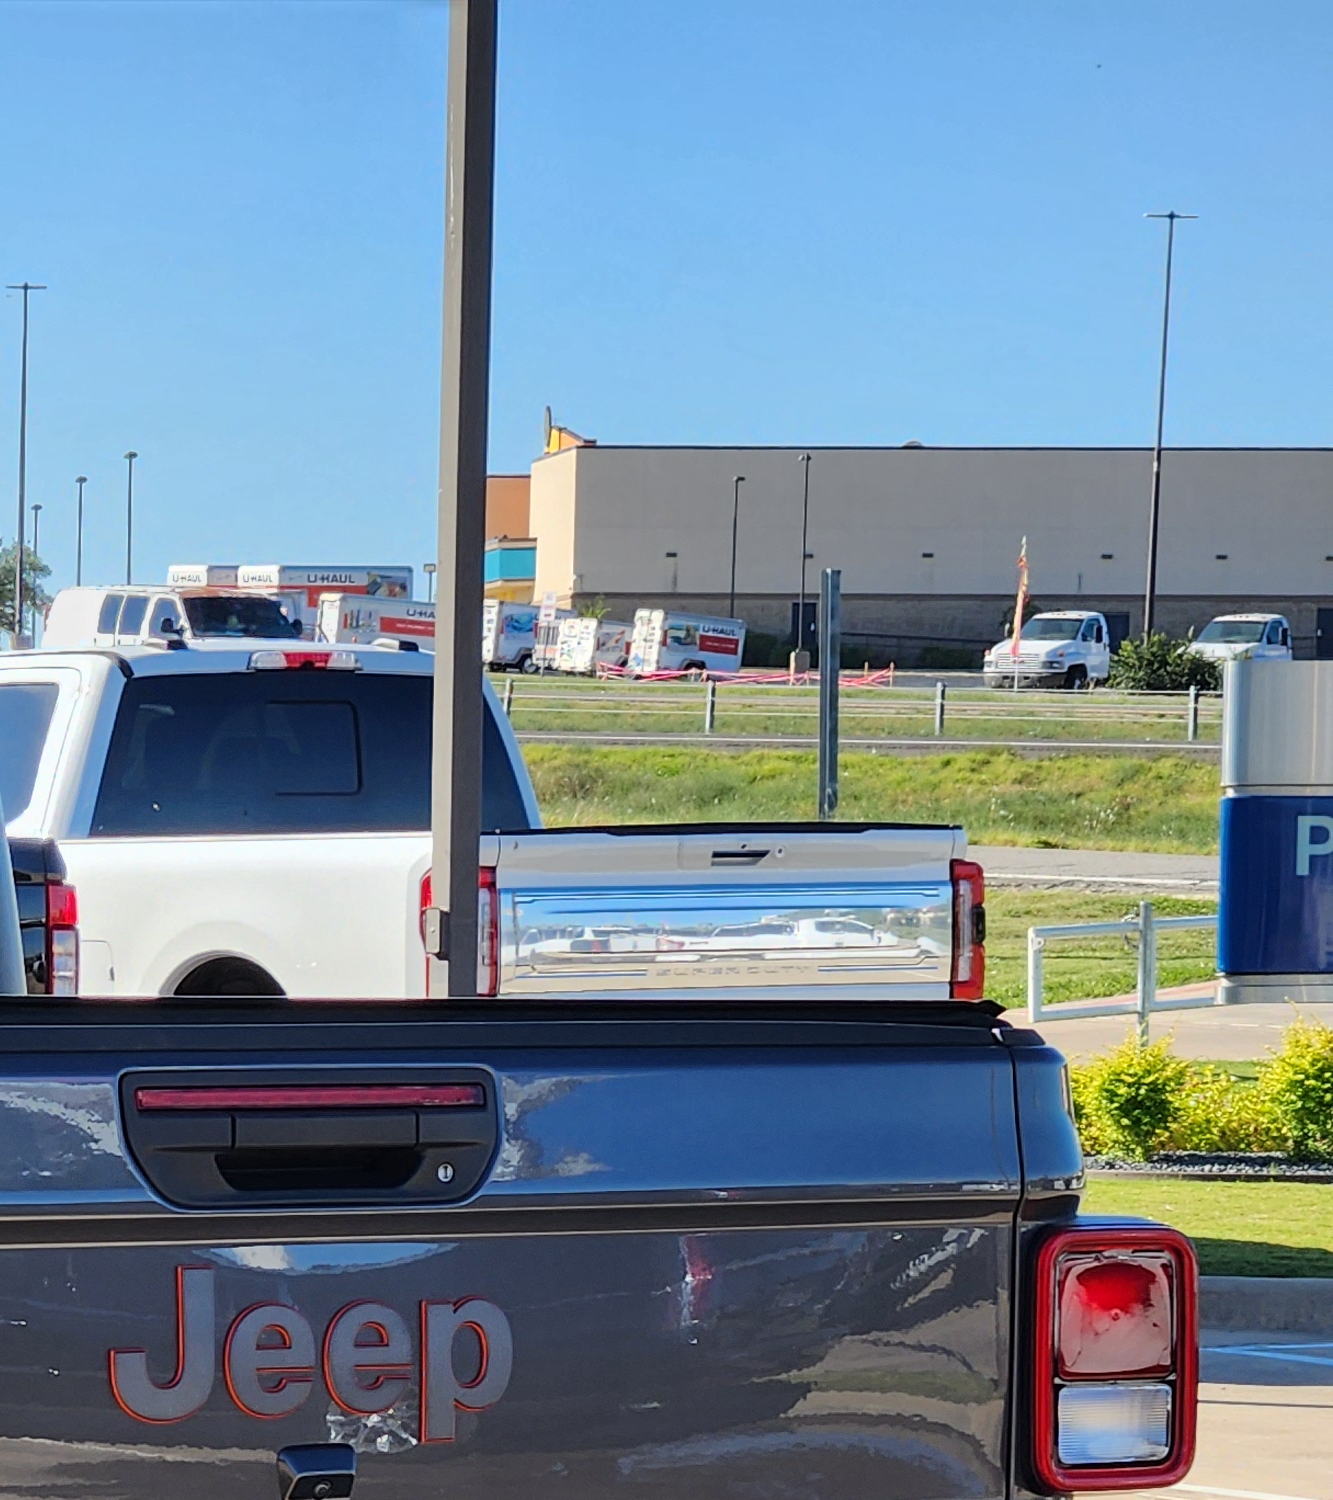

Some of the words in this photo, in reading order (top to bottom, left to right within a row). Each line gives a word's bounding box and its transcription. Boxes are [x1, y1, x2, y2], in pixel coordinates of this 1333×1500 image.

[307, 573, 356, 585] U-HAUL
[406, 608, 436, 619] U-HA
[702, 624, 738, 637] U-HAUL
[107, 1263, 514, 1445] Jeep
